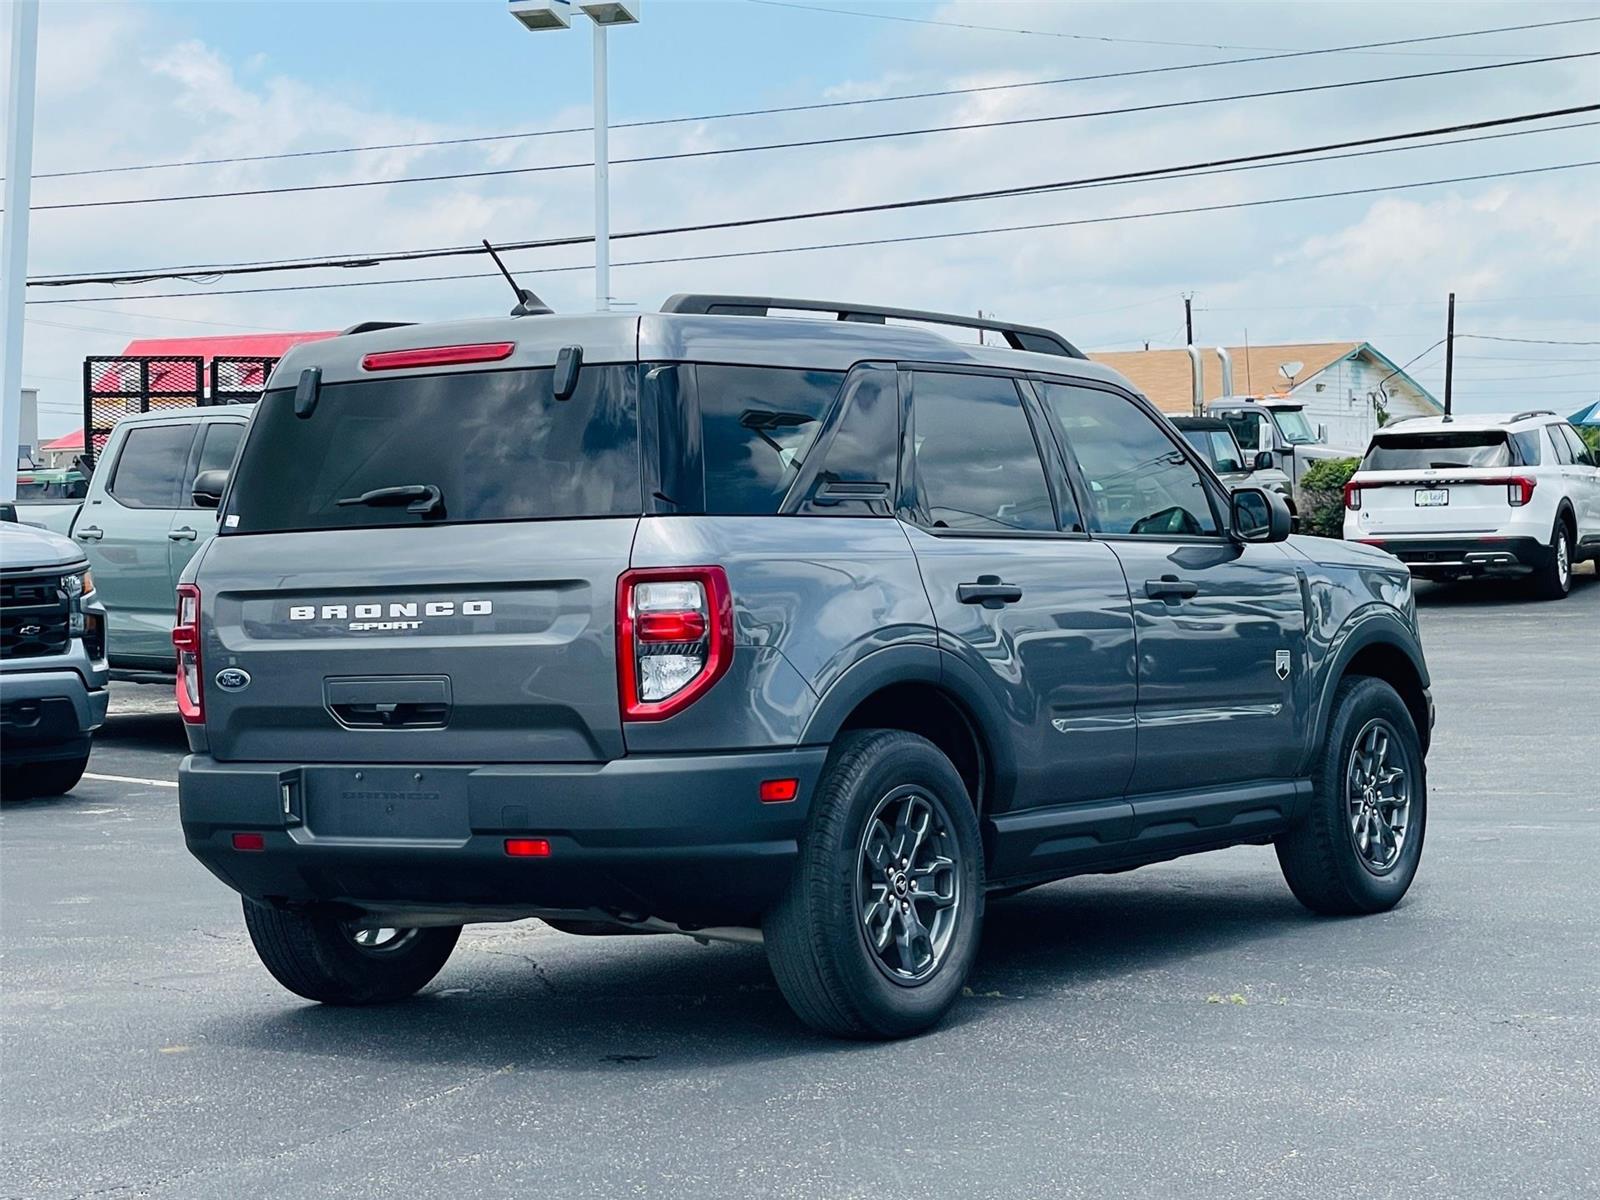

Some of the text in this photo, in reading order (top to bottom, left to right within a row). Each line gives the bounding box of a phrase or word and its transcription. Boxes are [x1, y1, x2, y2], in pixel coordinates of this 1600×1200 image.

[289, 601, 493, 620] BRONCO
[349, 620, 423, 631] SPORT
[342, 791, 440, 800] BRONCO
